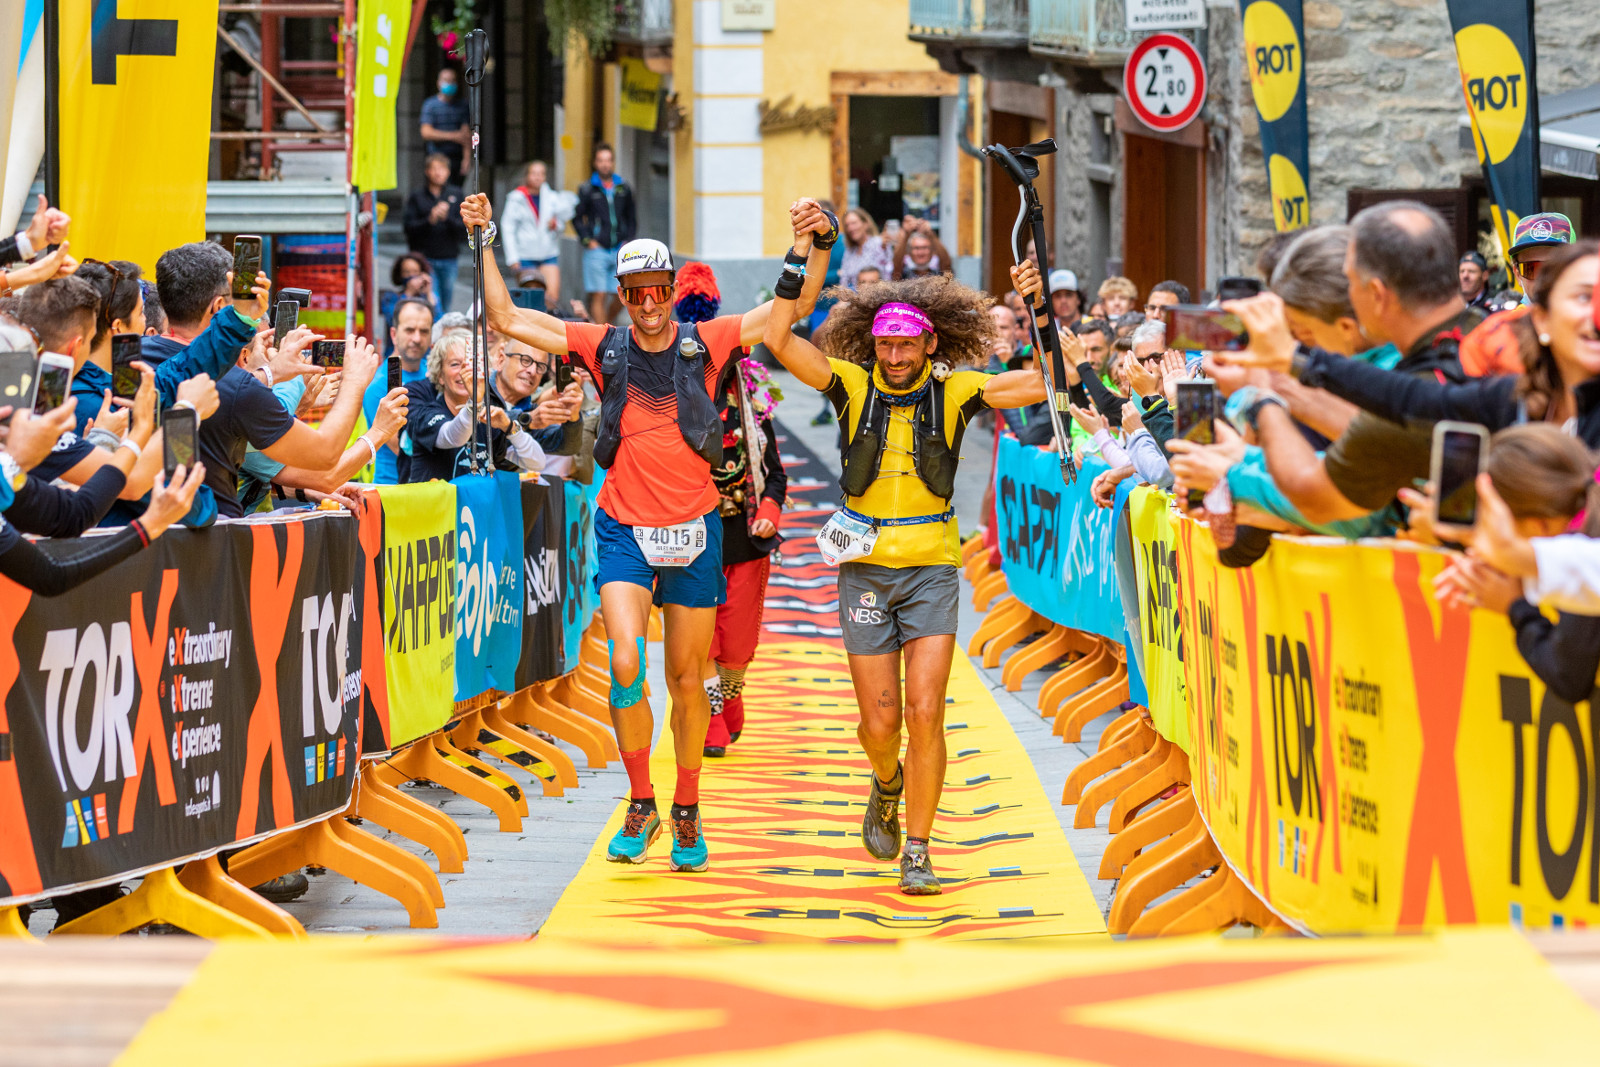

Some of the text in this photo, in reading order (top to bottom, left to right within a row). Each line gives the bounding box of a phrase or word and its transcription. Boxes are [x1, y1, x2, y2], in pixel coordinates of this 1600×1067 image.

[1134, 11, 1198, 23] autorizzati
[649, 528, 690, 546] 4015
[829, 528, 856, 550] 400
[848, 606, 881, 624] NBS
